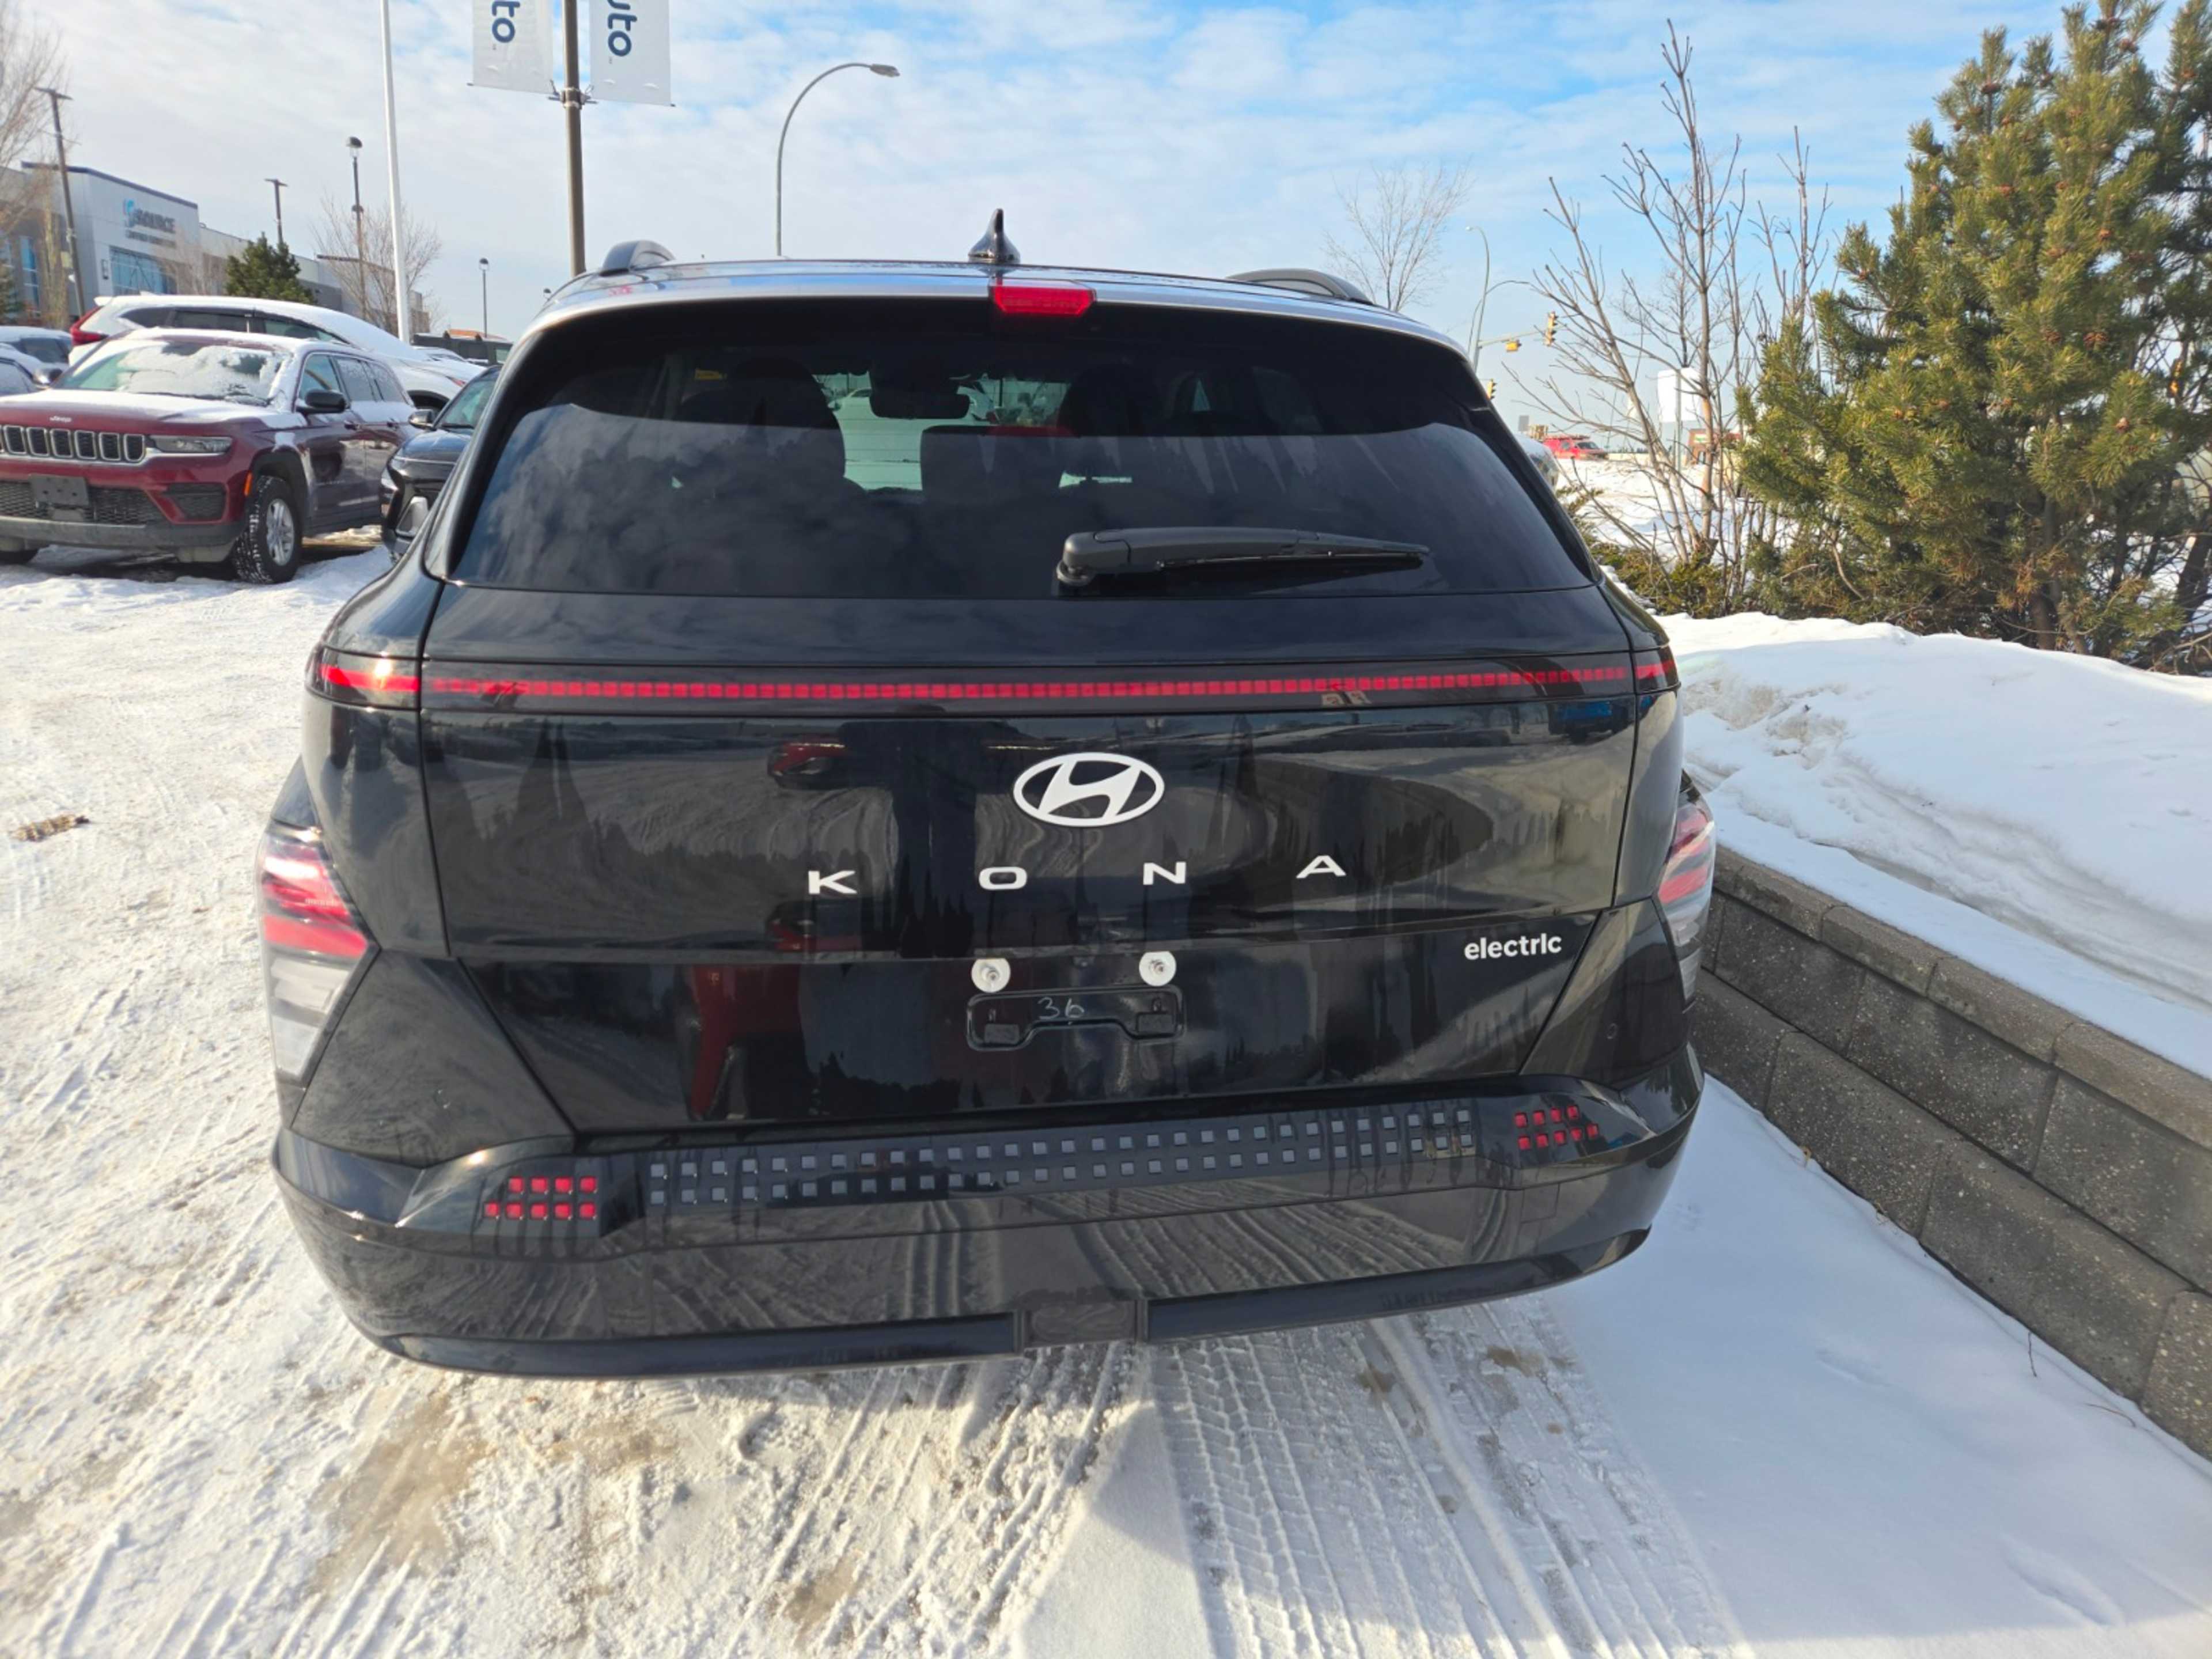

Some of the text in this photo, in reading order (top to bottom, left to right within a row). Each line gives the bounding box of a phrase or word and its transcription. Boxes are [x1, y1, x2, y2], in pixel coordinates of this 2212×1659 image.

[808, 855, 1346, 895] KONA
[1464, 933, 1562, 960] electric
[1037, 997, 1085, 1020] 36
